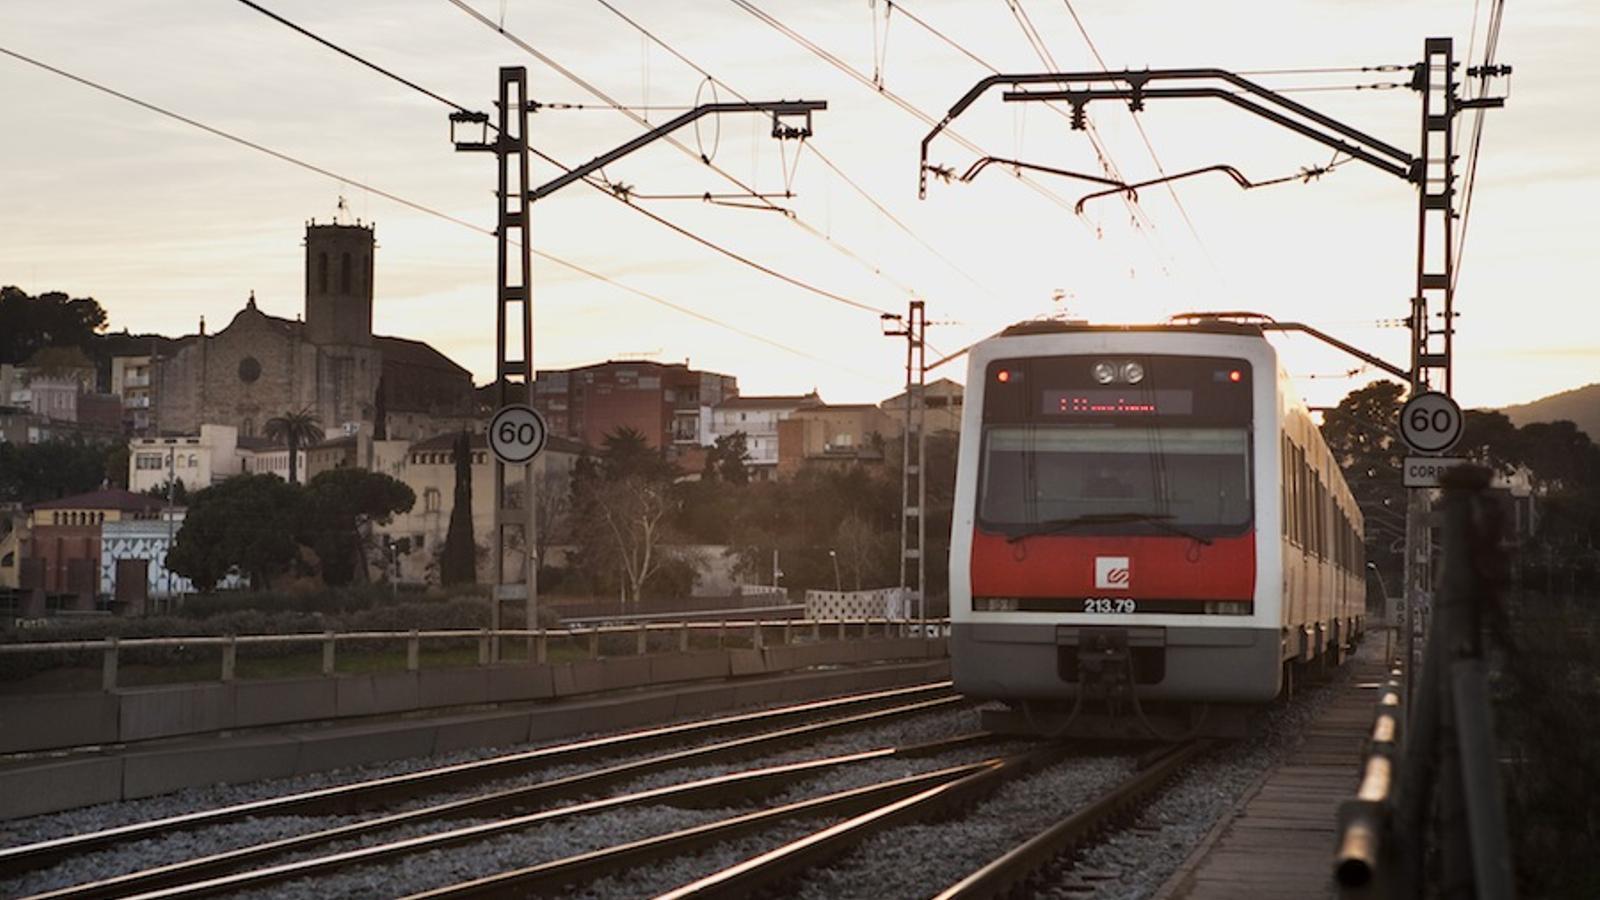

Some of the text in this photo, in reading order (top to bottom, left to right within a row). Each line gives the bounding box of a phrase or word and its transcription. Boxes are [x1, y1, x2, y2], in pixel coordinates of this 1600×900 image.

[1410, 407, 1451, 433] 60
[499, 420, 535, 446] 60
[1409, 465, 1450, 480] COR
[1084, 597, 1136, 613] 213.79
